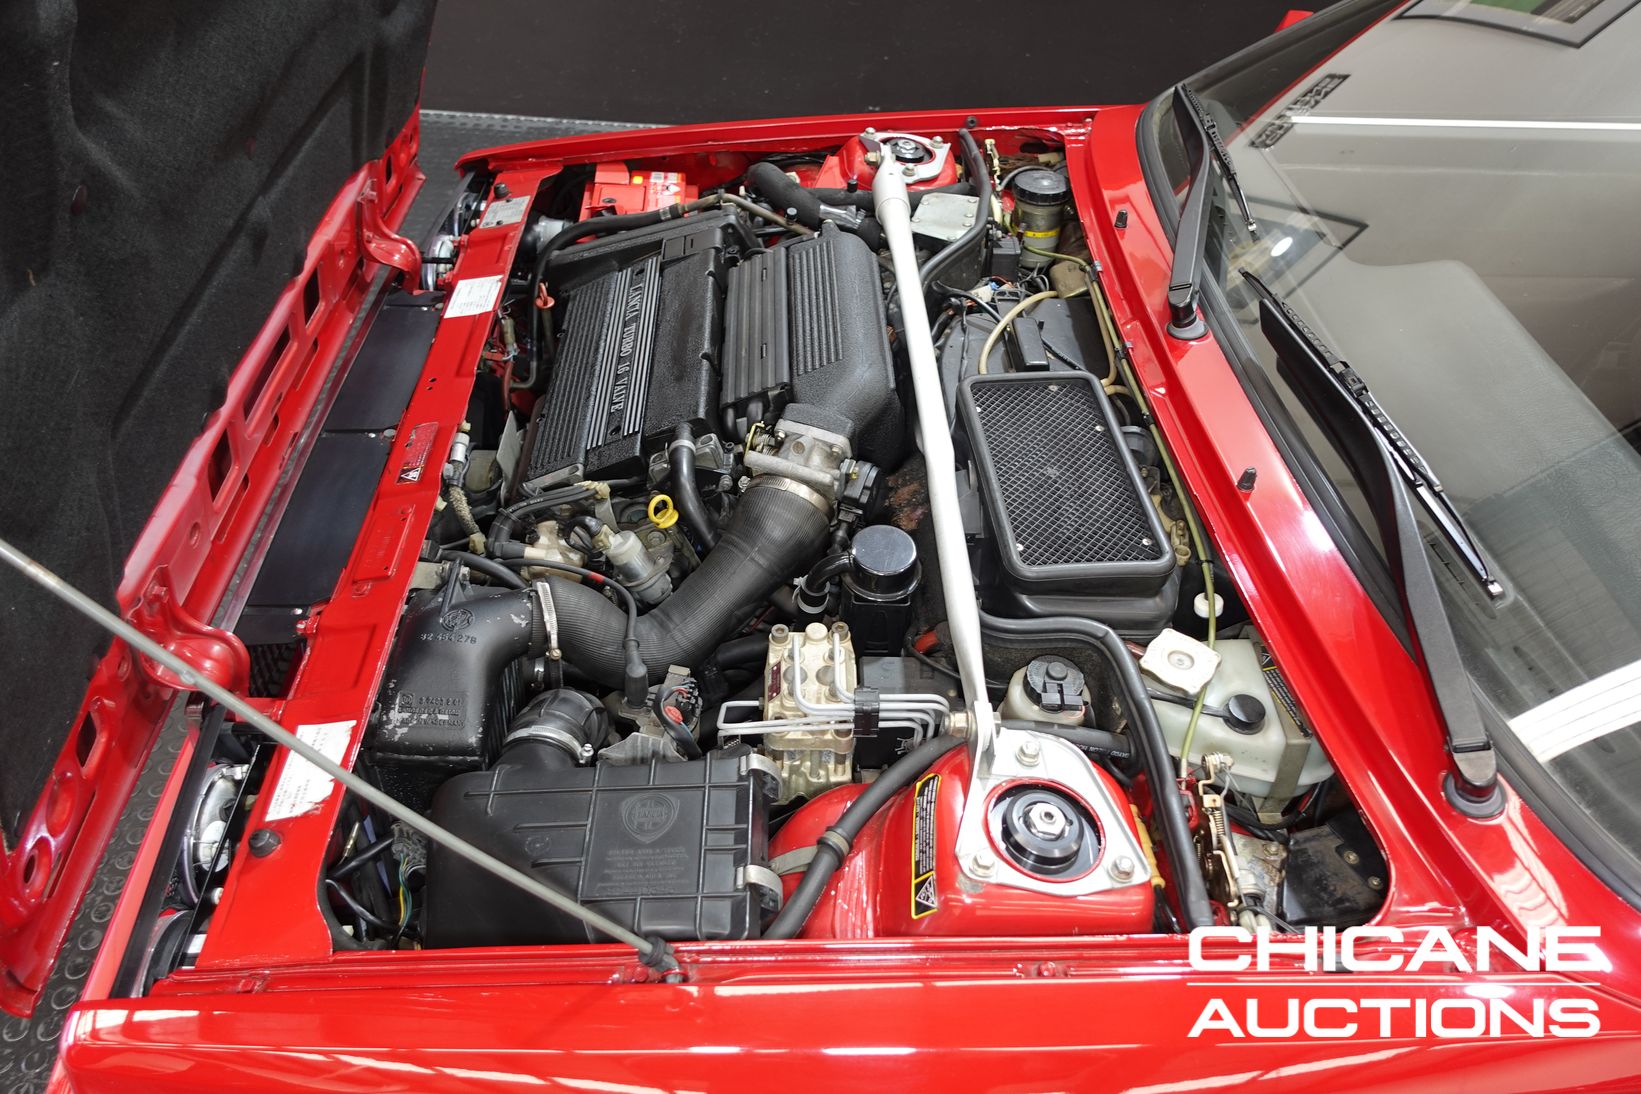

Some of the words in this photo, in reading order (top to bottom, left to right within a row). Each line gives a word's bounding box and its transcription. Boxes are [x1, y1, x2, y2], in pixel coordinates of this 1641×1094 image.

[626, 283, 643, 320] LANCIA
[620, 322, 636, 357] TURBO
[616, 361, 630, 374] 16
[610, 376, 628, 412] VALVE
